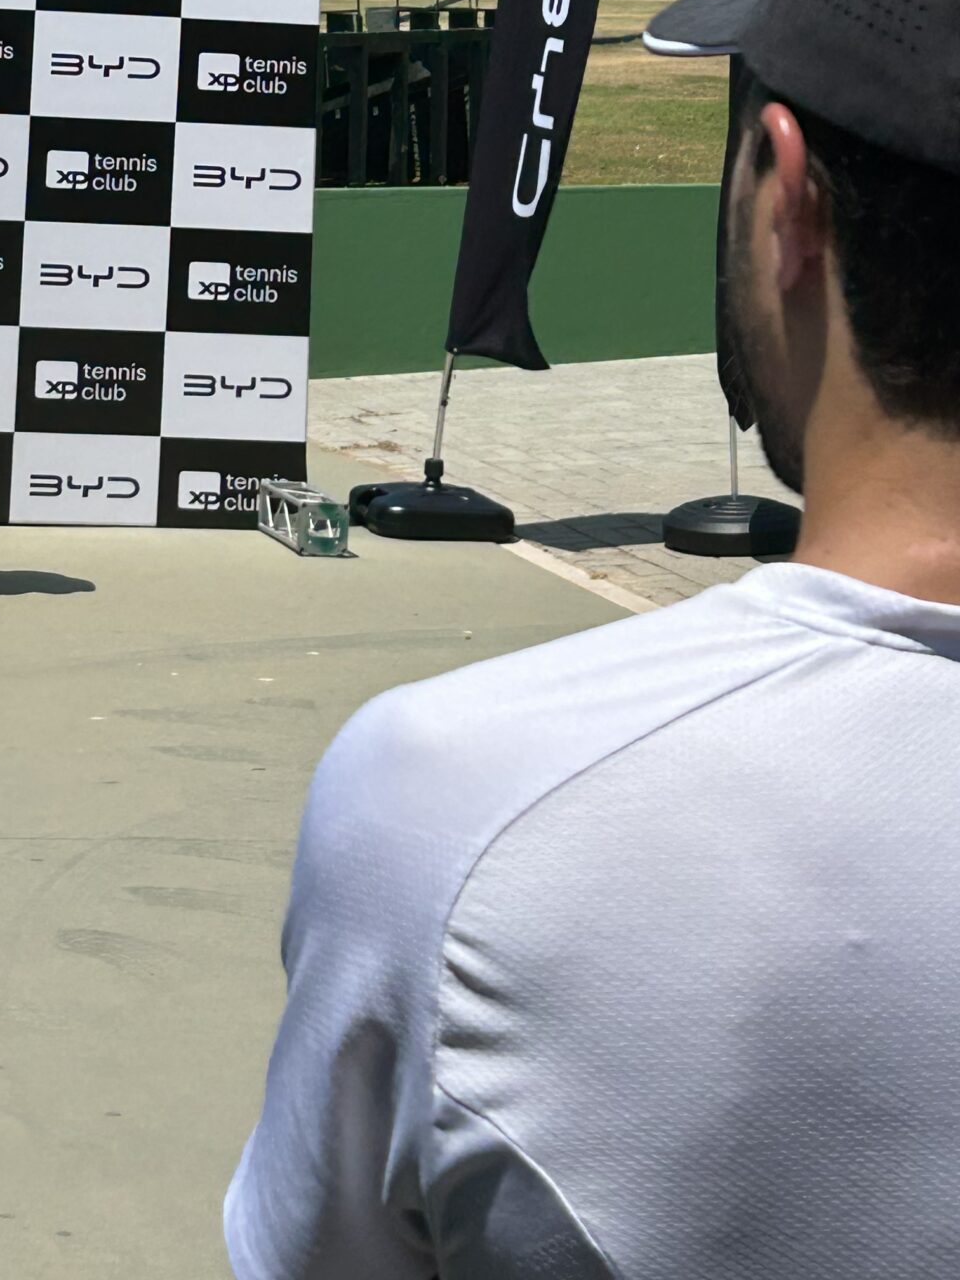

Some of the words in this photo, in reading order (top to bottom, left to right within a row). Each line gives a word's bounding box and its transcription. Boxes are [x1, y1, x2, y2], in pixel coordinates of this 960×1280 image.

[51, 54, 160, 79] BYD
[245, 56, 306, 74] tennis
[244, 76, 287, 94] club
[95, 154, 157, 172] tennis
[93, 174, 137, 191] club
[193, 165, 301, 190] BYD
[40, 264, 149, 288] BYD
[236, 265, 297, 283] tennis
[234, 284, 278, 303] club
[83, 363, 146, 381] tennis
[82, 383, 126, 401] club
[184, 375, 292, 399] BYD
[30, 475, 140, 498] BYD
[224, 493, 260, 512] clu
